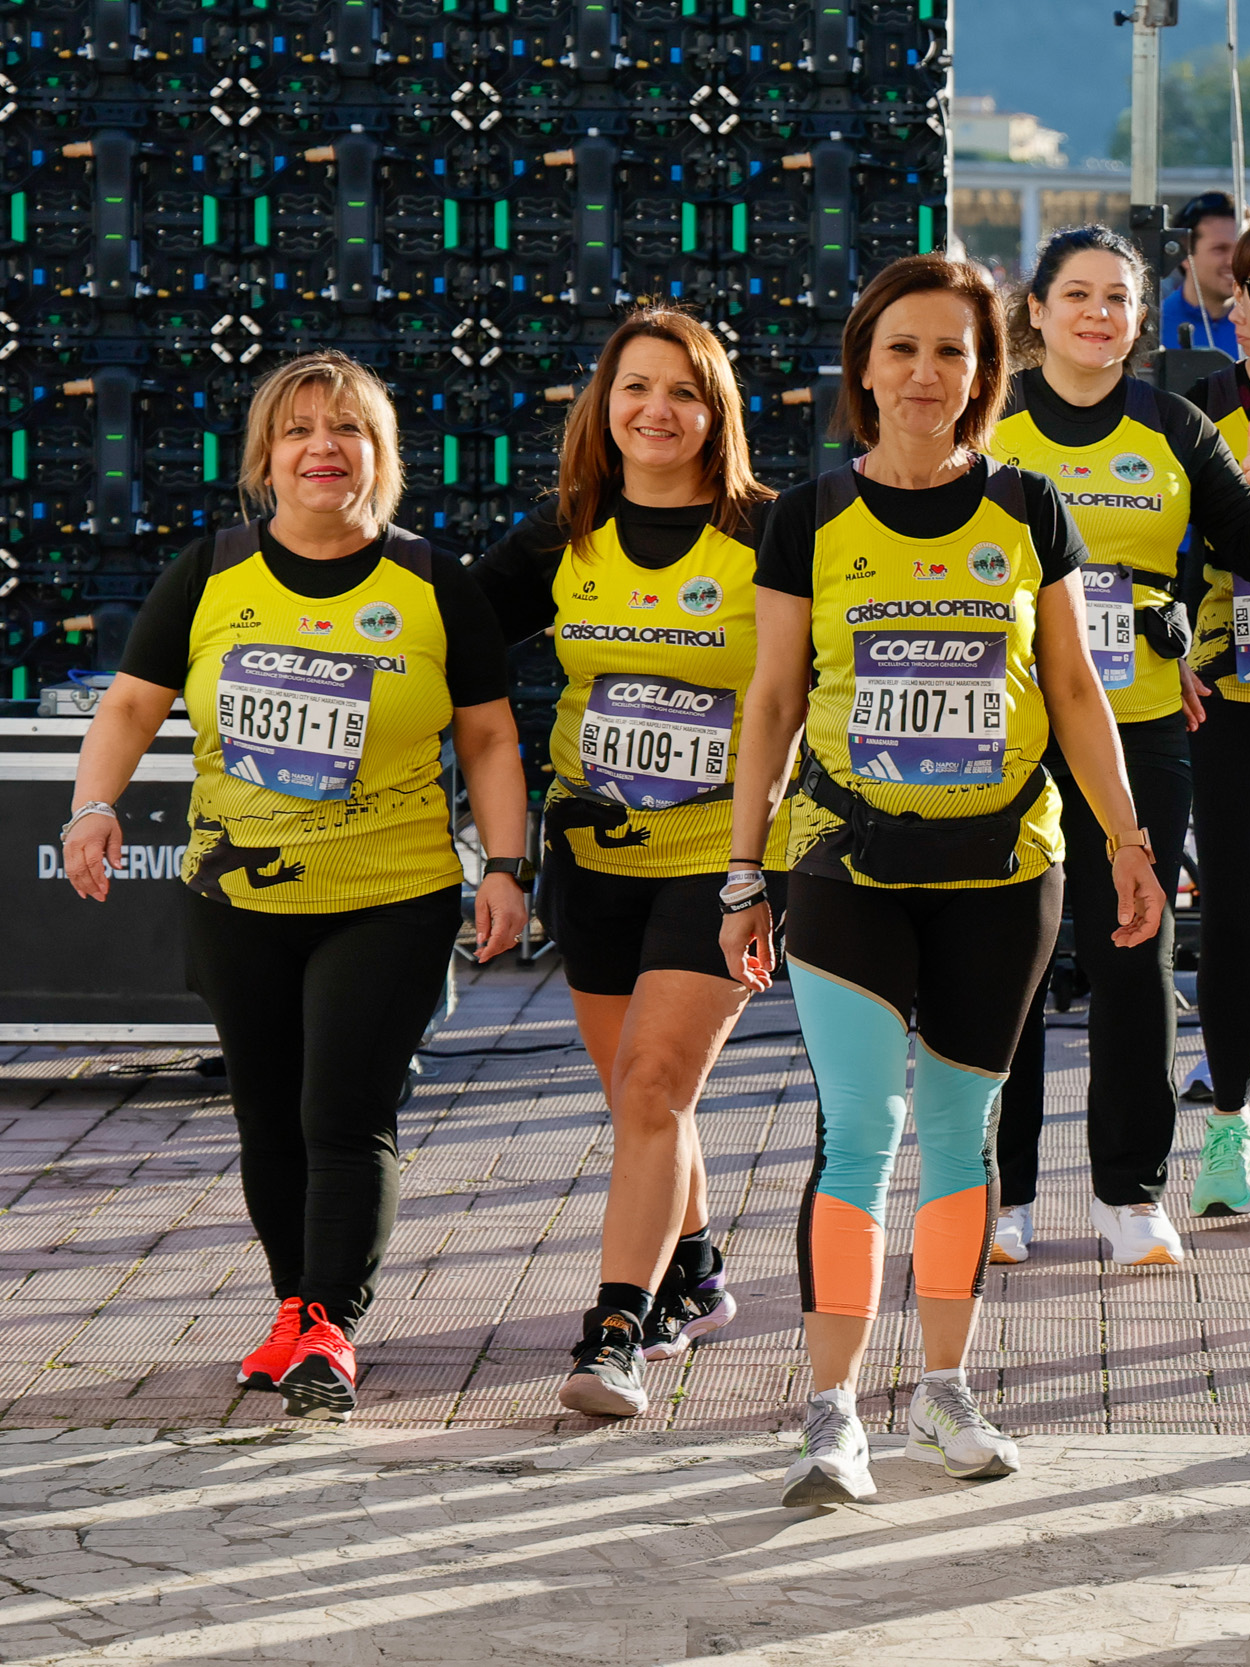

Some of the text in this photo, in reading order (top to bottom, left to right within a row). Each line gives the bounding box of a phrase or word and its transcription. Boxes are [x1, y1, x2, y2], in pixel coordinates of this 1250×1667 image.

[846, 570, 876, 581] HALLOP
[572, 592, 598, 602] HALLOP
[869, 640, 985, 661] COELMO
[240, 650, 353, 682] COELMO
[245, 669, 344, 687] EXCELLENCE THROUGH GENERATIONS
[607, 682, 714, 712] COELMO
[641, 704, 668, 713] THROUGH
[668, 708, 706, 717] GENERATIONS
[875, 689, 974, 733] R107-1
[240, 695, 338, 749] R331-1
[603, 726, 700, 777] R109-1
[992, 742, 998, 752] G
[348, 760, 355, 770] G
[292, 773, 314, 782] NAPOLI
